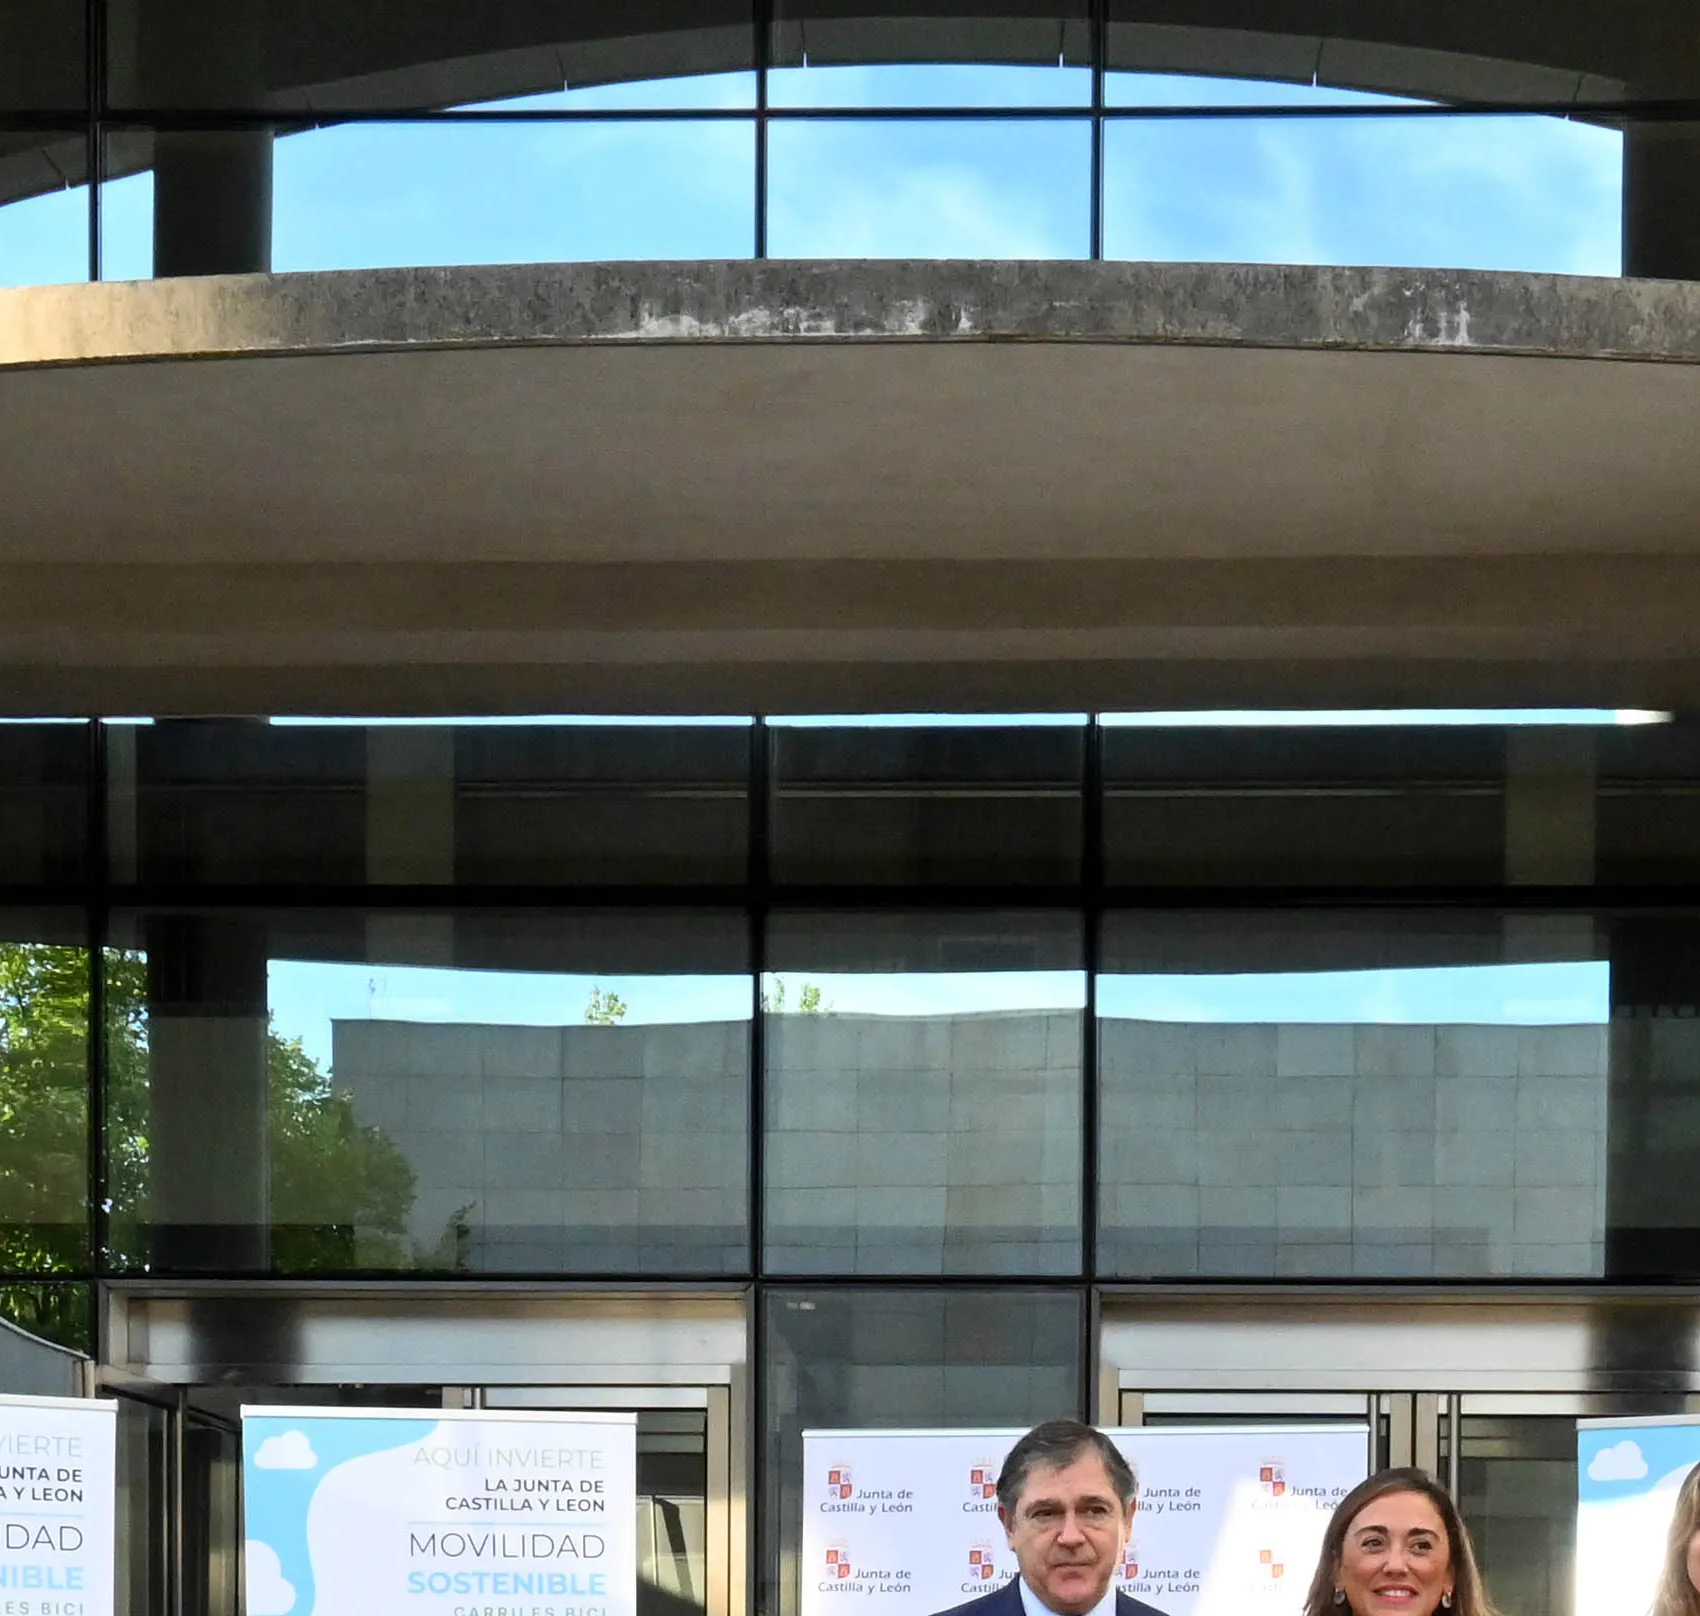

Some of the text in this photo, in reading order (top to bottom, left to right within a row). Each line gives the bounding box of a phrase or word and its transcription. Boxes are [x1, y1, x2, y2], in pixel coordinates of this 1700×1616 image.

[56, 1468, 82, 1483] DE
[484, 1478, 604, 1494] LA JUNTA DE
[13, 1486, 25, 1500] Y
[31, 1487, 83, 1503] LEON
[856, 1489, 913, 1500] Junta de
[445, 1496, 605, 1512] CASTILLA Y LEON
[819, 1502, 913, 1516] Castilla y León
[410, 1532, 605, 1559] MOVILIDAD
[854, 1568, 912, 1580] Junta de
[407, 1570, 606, 1596] SOSTENIBLE
[817, 1581, 912, 1596] Castilla y León
[40, 1601, 84, 1616] BICI
